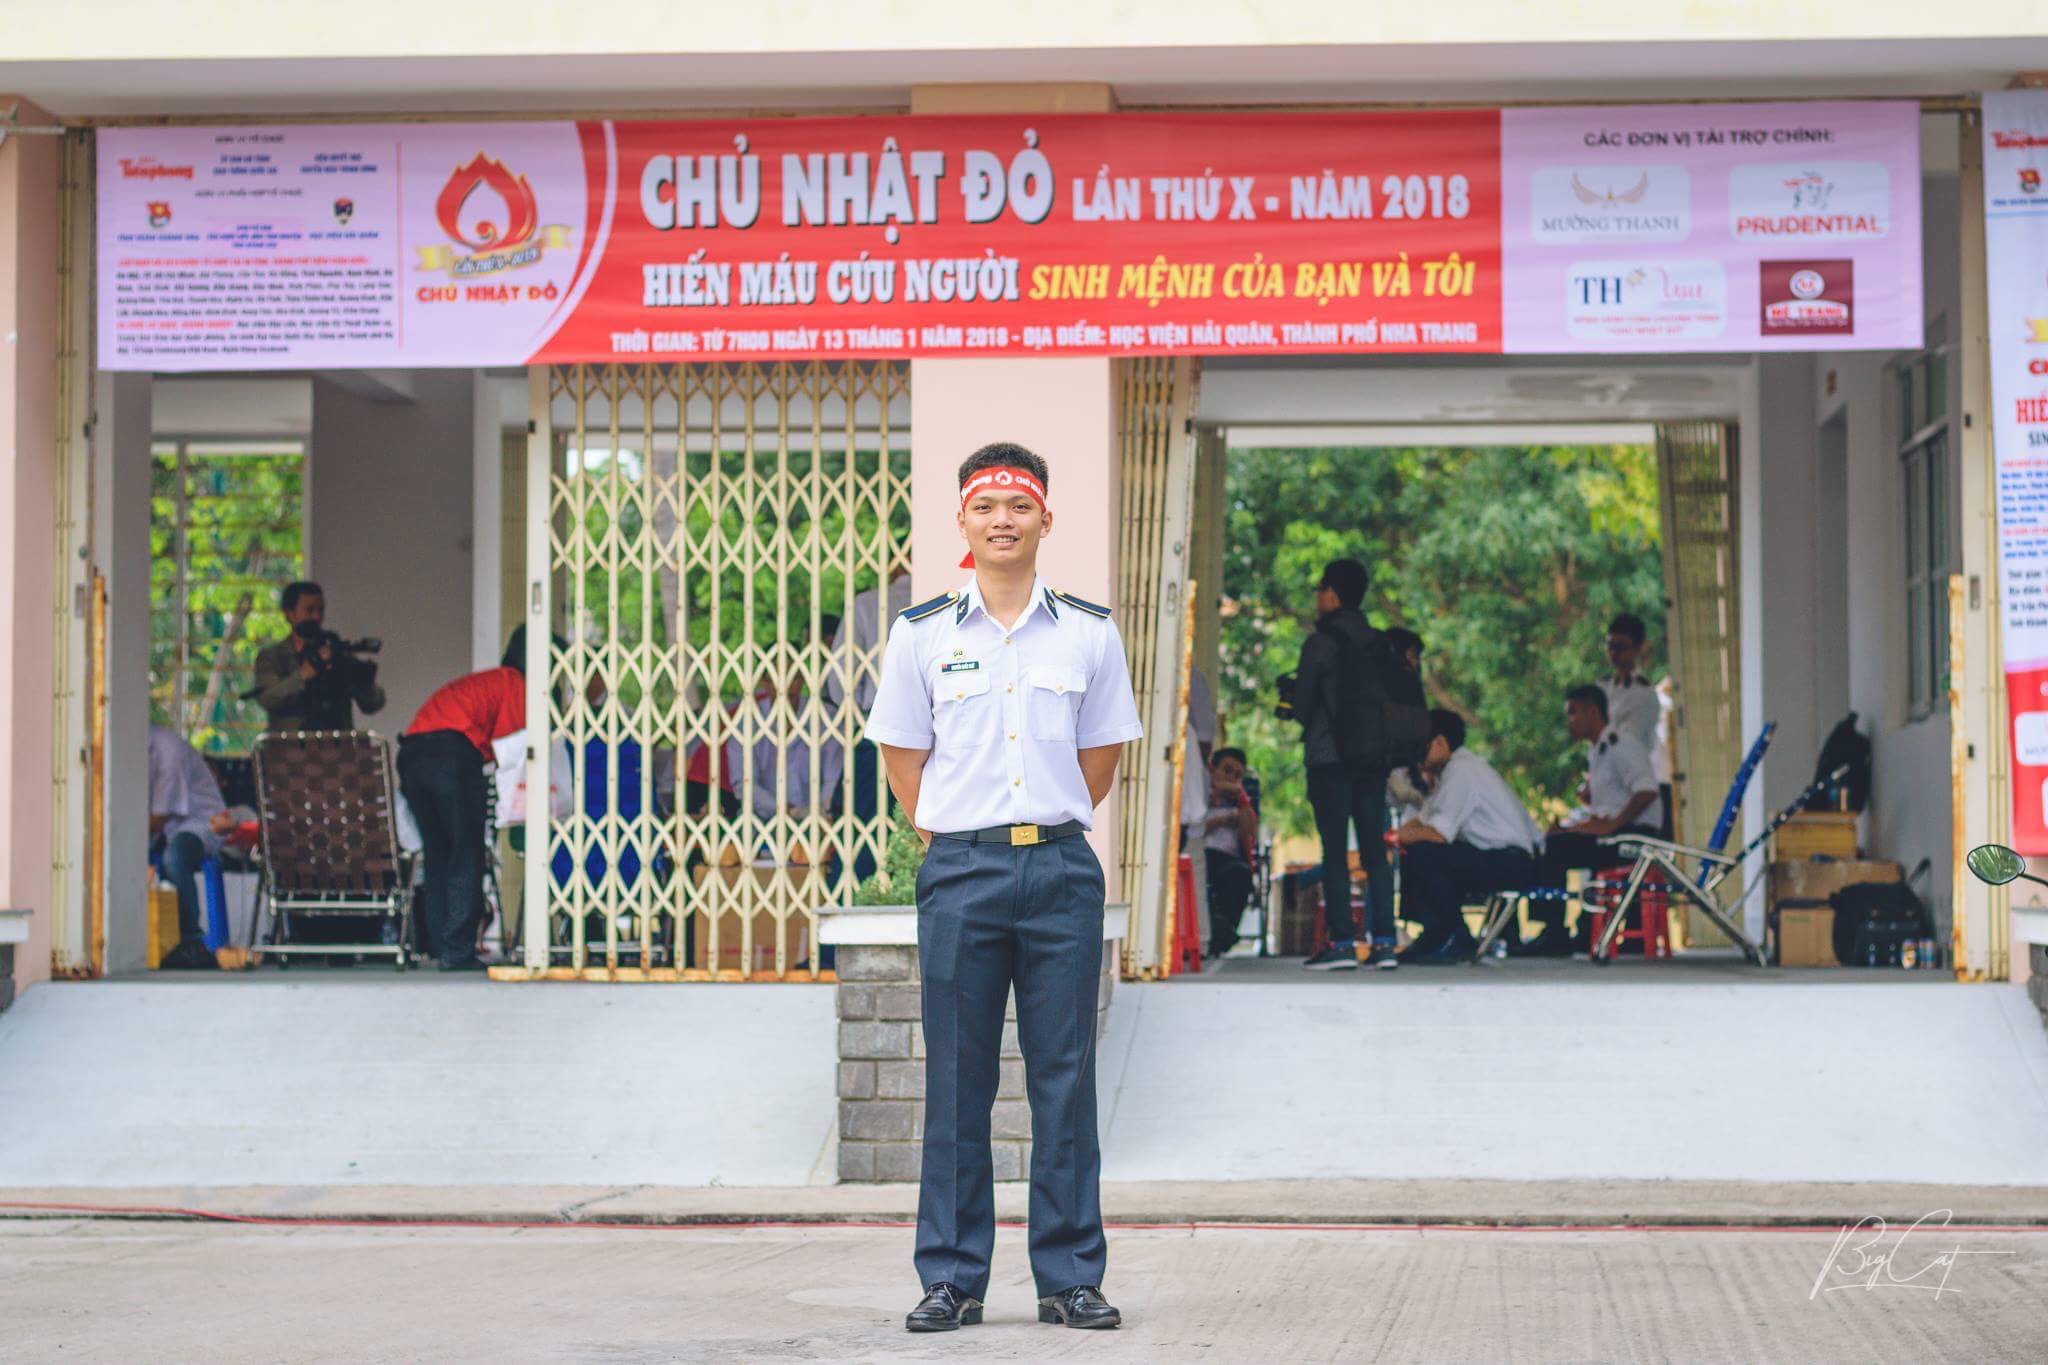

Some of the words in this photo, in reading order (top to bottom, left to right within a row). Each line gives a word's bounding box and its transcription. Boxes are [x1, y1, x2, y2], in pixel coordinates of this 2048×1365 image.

[1584, 130, 1622, 147] CÁC
[1627, 130, 1669, 146] ĐƠN
[1674, 132, 1691, 148] VỊ
[1696, 128, 1726, 145] TÀI
[1730, 129, 1768, 146] TRỢ
[639, 134, 761, 230] CHỦ
[781, 136, 945, 243] NHẬT
[960, 128, 1055, 224] ĐỎ
[1151, 166, 1224, 222] THỨ
[1229, 175, 1257, 221] X
[1264, 195, 1279, 213] -
[1290, 167, 1374, 221] NĂM
[1382, 173, 1470, 220] 2018
[1616, 216, 1680, 231] THANH
[1737, 214, 1882, 234] PRUDENTIAL
[642, 249, 731, 306] HIẾN
[739, 252, 818, 306] MÁU
[826, 251, 897, 304] CỨU
[904, 248, 1019, 303] NGƯỜI
[1029, 263, 1111, 300] SINH
[1117, 255, 1214, 307] MỆNH
[1222, 252, 1286, 299] CỦA
[1294, 261, 1362, 306] BẠN
[1371, 251, 1412, 297] VÀ
[1421, 252, 1477, 297] TÔI
[1574, 276, 1622, 305] TH
[652, 331, 699, 352] GIAN:
[702, 327, 727, 351] TỪ
[773, 326, 819, 350] NGÀY
[822, 329, 844, 349] 13
[848, 325, 904, 349] THÁNG
[907, 328, 918, 349] 1
[921, 324, 963, 348] NĂM
[966, 327, 1009, 348] 2018
[1109, 325, 1146, 350] HỌC
[1149, 322, 1189, 349] VIỆN
[1192, 319, 1221, 346] HẢI
[1281, 320, 1339, 344] THÀNH
[1341, 316, 1379, 344] PHỐ
[1381, 322, 1418, 344] NHA
[1421, 321, 1478, 343] TRANG
